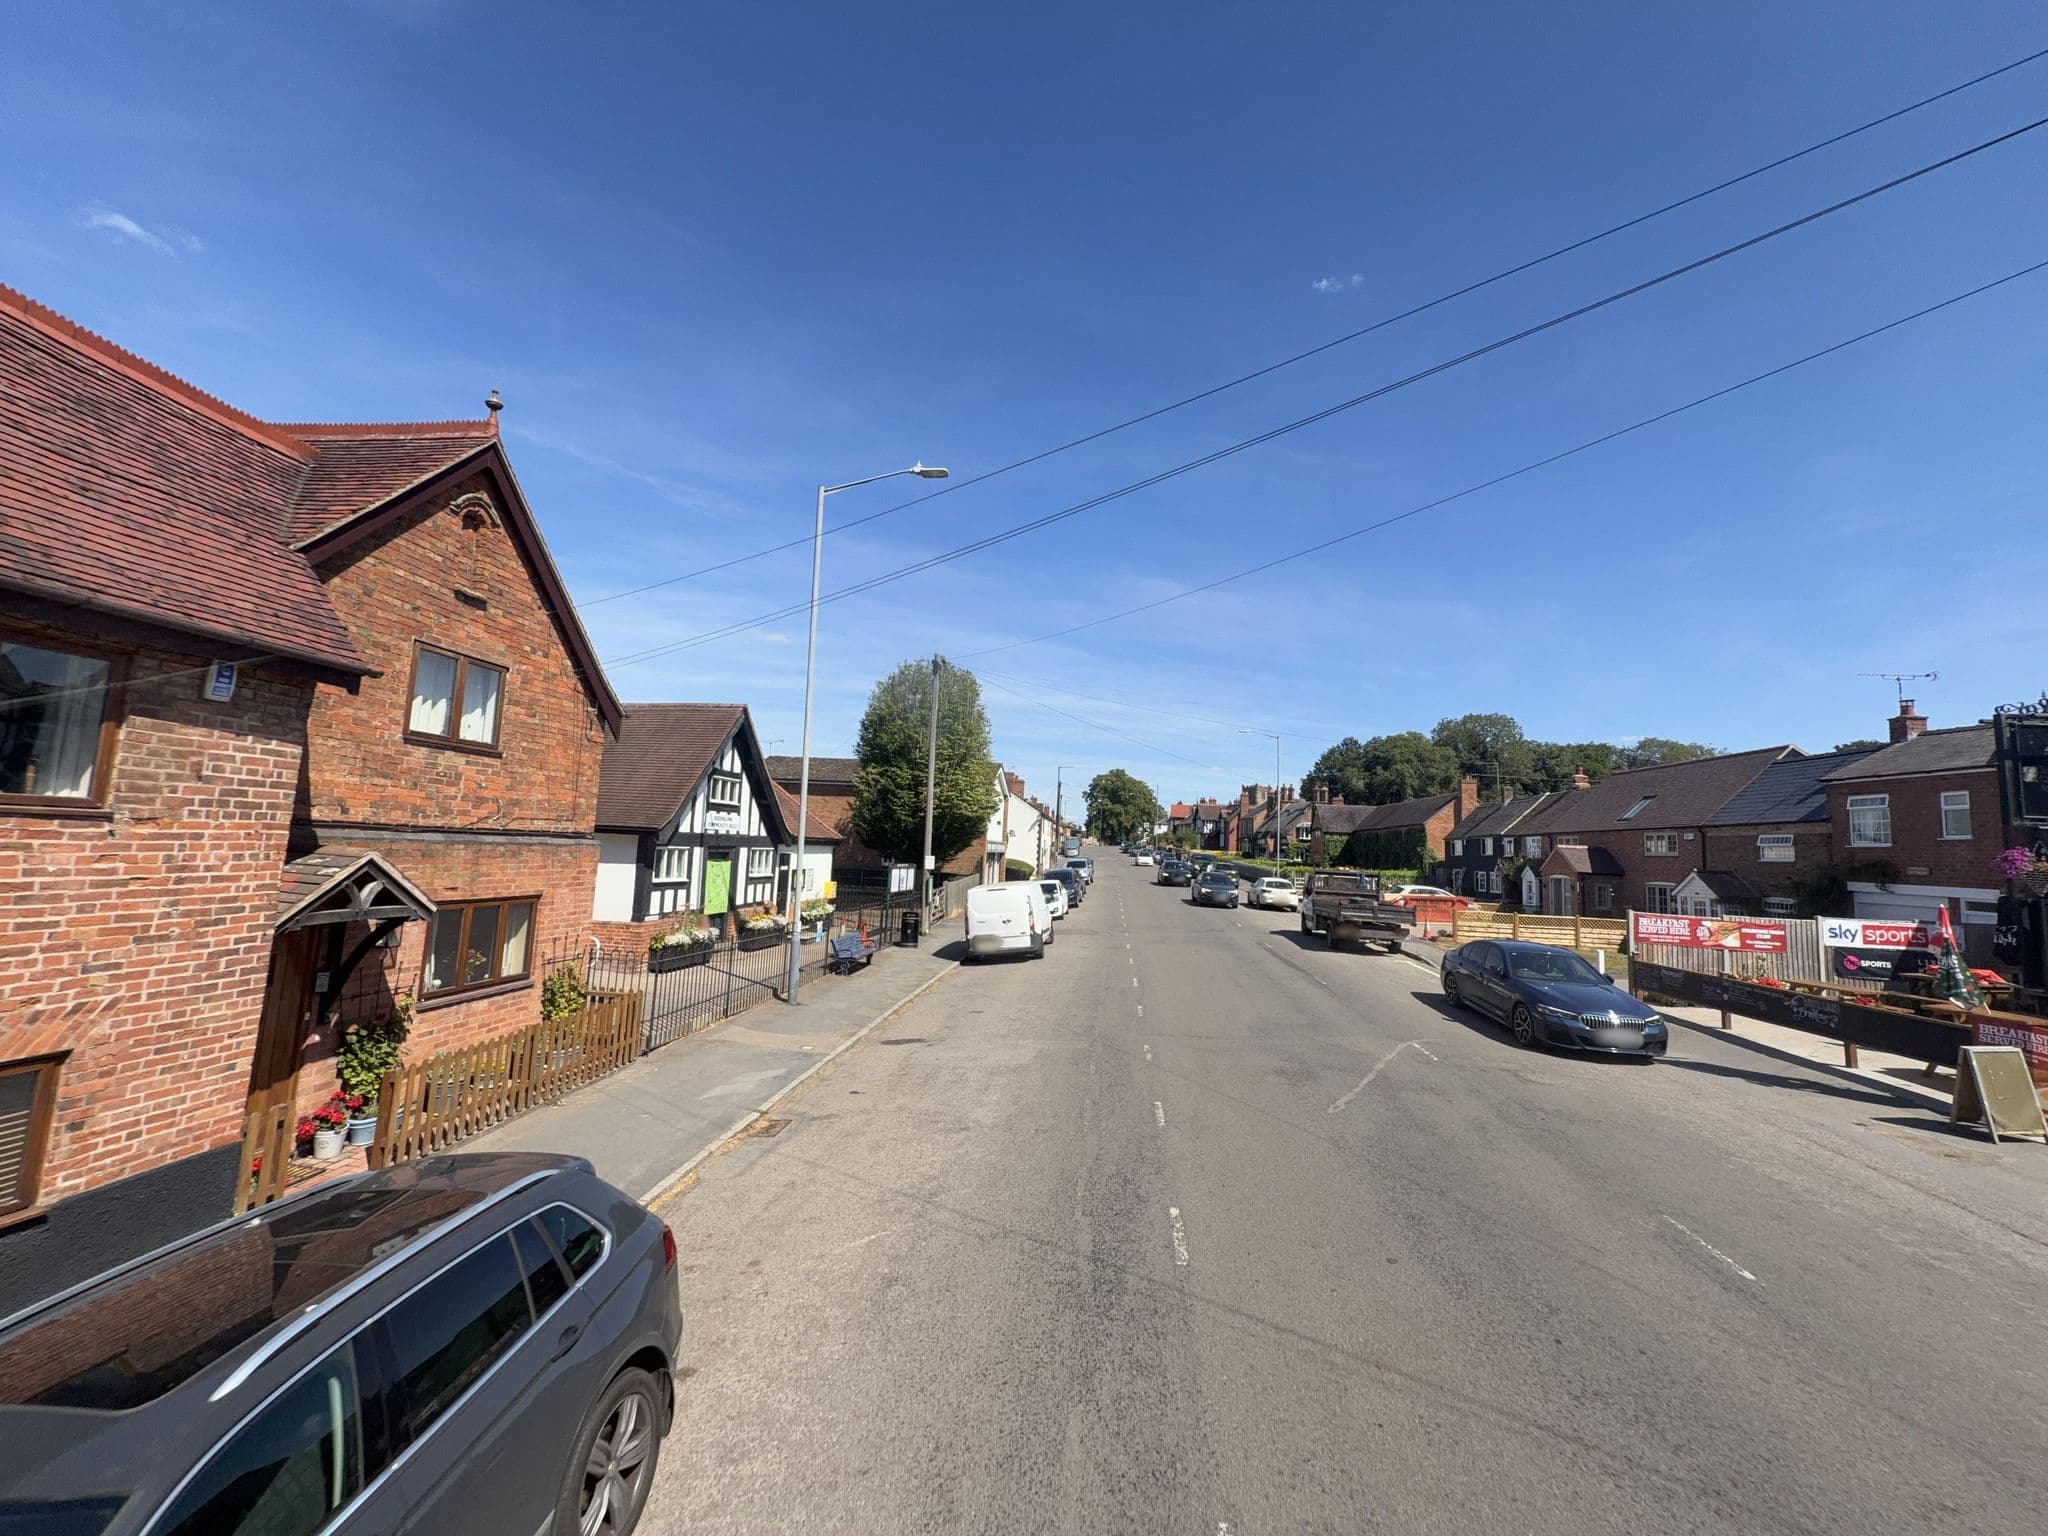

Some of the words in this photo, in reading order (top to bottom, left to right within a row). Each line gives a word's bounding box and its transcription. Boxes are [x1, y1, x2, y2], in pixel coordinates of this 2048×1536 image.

[1639, 916, 1690, 928] BREAKFAST
[1639, 925, 1669, 935] SERVED
[1828, 924, 1858, 943] sky
[1864, 928, 1926, 944] sports
[1860, 960, 1892, 969] SPORTS
[1979, 1023, 2048, 1046] BREAKFAST
[1979, 1033, 2025, 1049] SERVED
